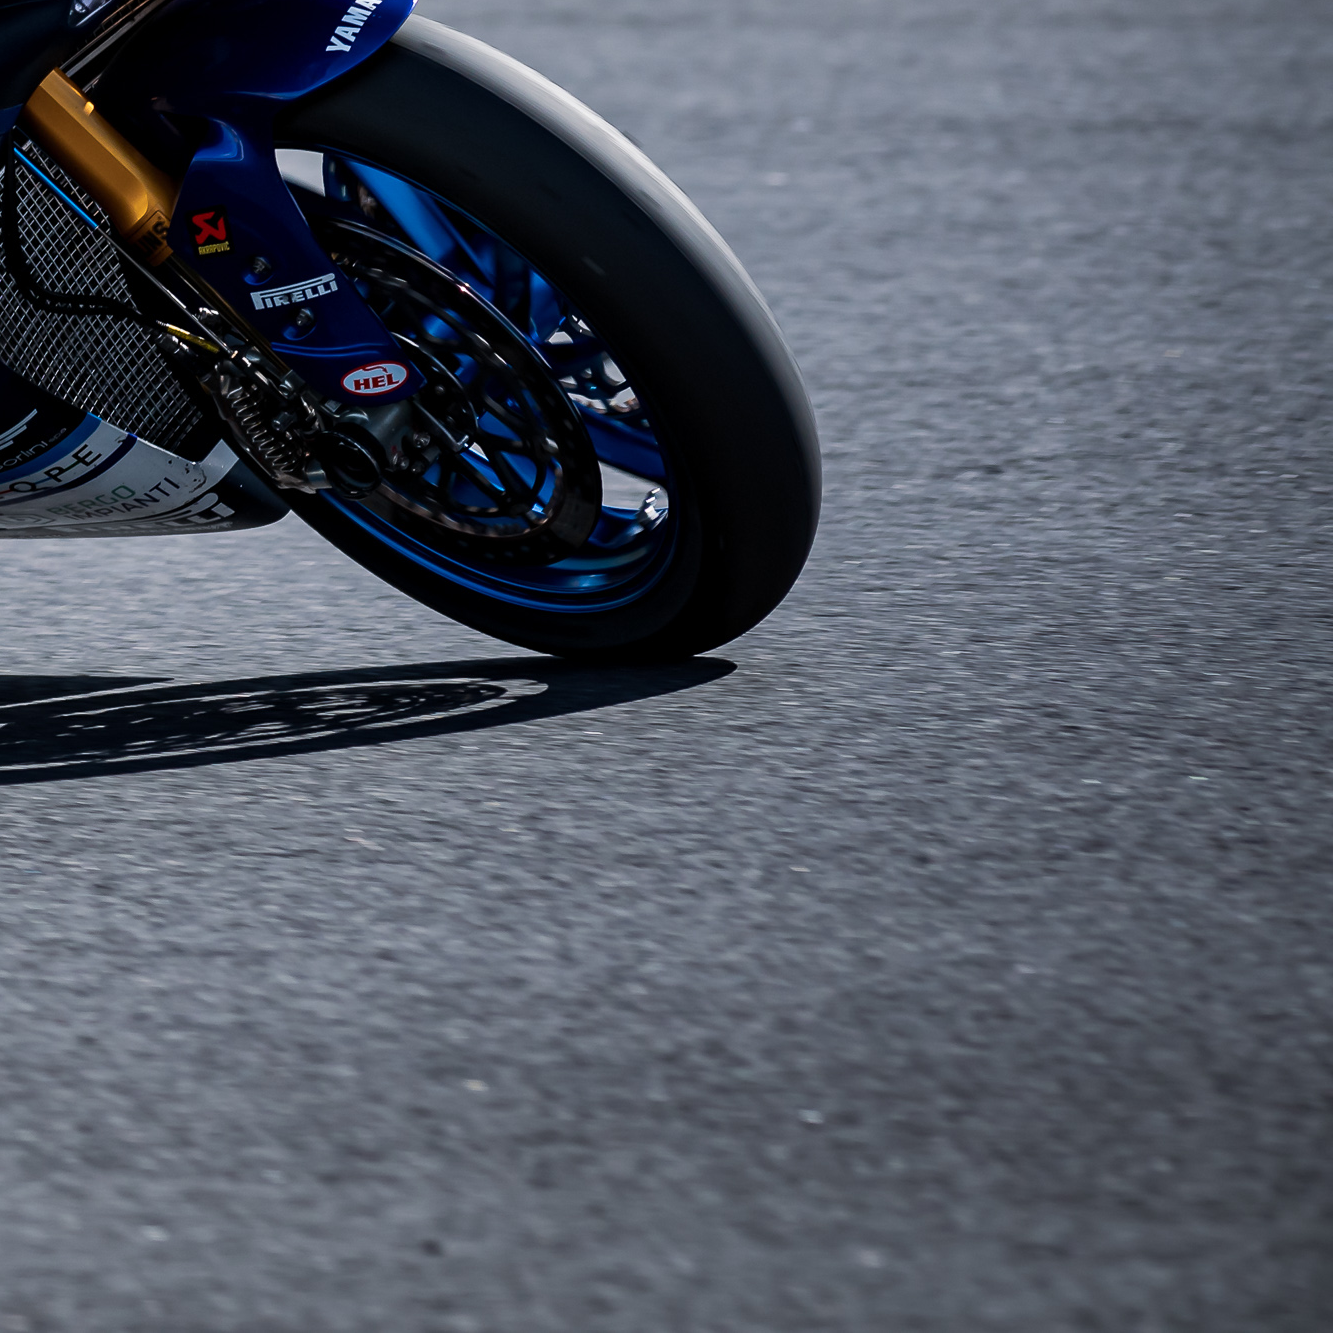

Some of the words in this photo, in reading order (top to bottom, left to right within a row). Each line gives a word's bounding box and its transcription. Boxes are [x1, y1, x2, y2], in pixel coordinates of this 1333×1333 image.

[250, 272, 339, 311] PIRELLI
[353, 369, 401, 391] HEL
[46, 484, 136, 517] BERGO
[64, 476, 181, 521] IMPIANTI
